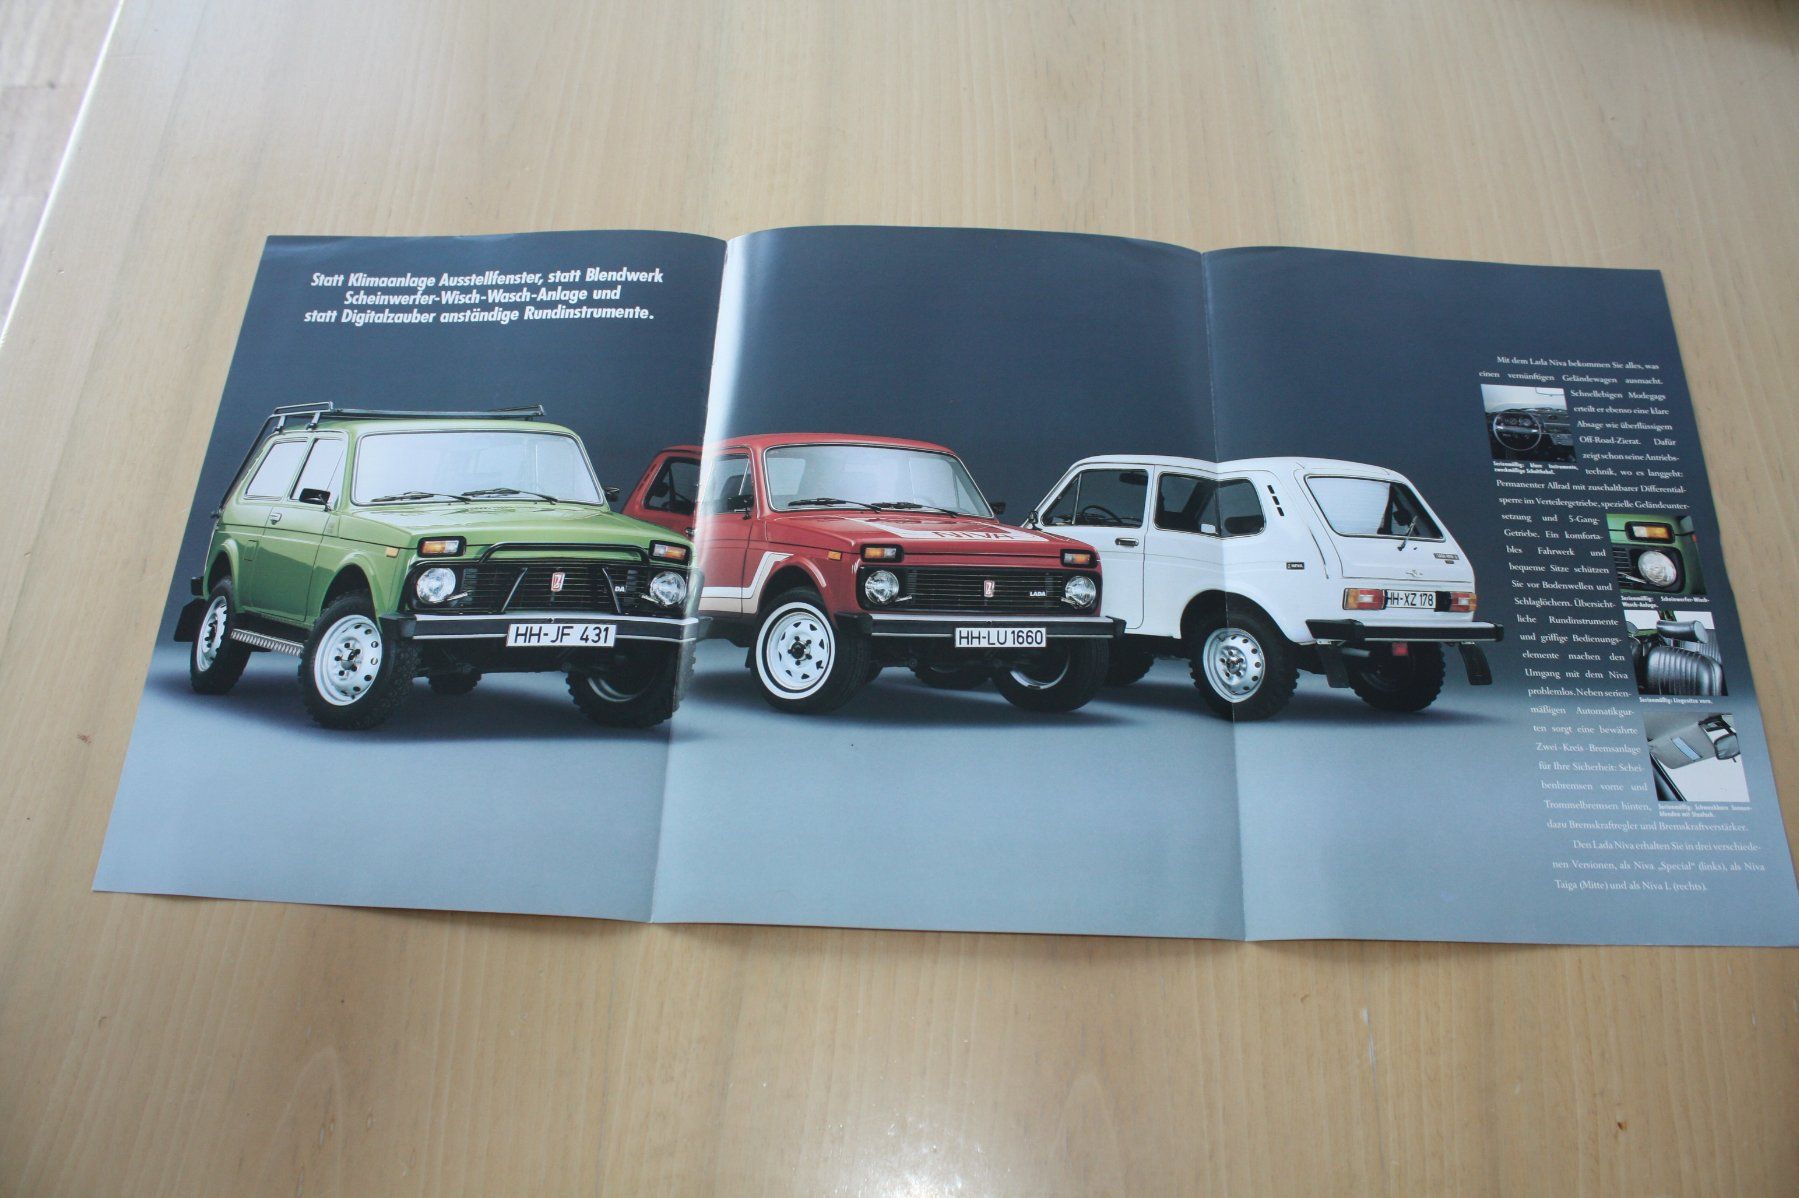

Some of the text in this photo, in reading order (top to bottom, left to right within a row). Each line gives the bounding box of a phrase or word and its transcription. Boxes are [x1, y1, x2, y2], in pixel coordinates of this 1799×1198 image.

[311, 266, 663, 291] Statt Klimaanlage Ausstellfenster, statt Blendwerk
[344, 284, 621, 304] Scheinwerfer-Wisch-Wasch-Anlage und
[304, 304, 654, 326] statt Digitalzauber anständige Rundinstrumente.
[1567, 359, 1611, 368] bekommen
[1507, 372, 1555, 382] vernünftigen
[1562, 374, 1617, 384] Geländewagen
[1570, 389, 1666, 401] Schnellebigen Modegags
[1577, 420, 1603, 430] Absage
[1620, 421, 1672, 431] überflüssigem
[1579, 435, 1641, 444] Off-Road-Zierat.
[1582, 452, 1600, 461] zeigt
[1645, 453, 1679, 461] Antriebs-
[1585, 467, 1617, 476] technik,
[1647, 468, 1683, 479] langgeht:
[1496, 479, 1545, 488] Permanenter
[1547, 481, 1570, 490] Allrad
[1588, 483, 1638, 492] zuschaltbarer
[1640, 484, 1686, 493] Differential-
[1600, 499, 1634, 509] spezielle
[1634, 500, 1689, 509] Geländeunter-
[1501, 514, 1532, 522] setzung
[1568, 514, 1599, 525] 5-Gang-
[1504, 528, 1540, 537] Getriebe.
[1564, 530, 1602, 539] komforta-
[1506, 545, 1606, 556] bles Fahrwerk und
[1508, 562, 1545, 573] bequeme
[1574, 564, 1609, 573] schützen
[1542, 580, 1594, 590] Bodenwellen
[1596, 582, 1612, 590] und
[1420, 593, 1434, 606] 178
[1573, 598, 1615, 608] Übersicht-
[1516, 614, 1618, 625] liche Rundinstrumente
[514, 626, 610, 644] HH-JF 431
[959, 630, 1043, 645] HH-LU 1660
[1519, 632, 1621, 645] und griffige Bedienungs-
[1522, 650, 1625, 661] elemente machen den
[1524, 668, 1561, 679] Umgang
[1585, 669, 1604, 678] dem
[1608, 671, 1628, 679] Niva
[1576, 688, 1603, 696] Neben
[1530, 705, 1634, 718] mäßigen Automatikgur-
[1551, 726, 1572, 734] sorgt
[1599, 724, 1638, 734] bewährte
[1538, 760, 1551, 770] für
[1553, 761, 1570, 770] Ihre
